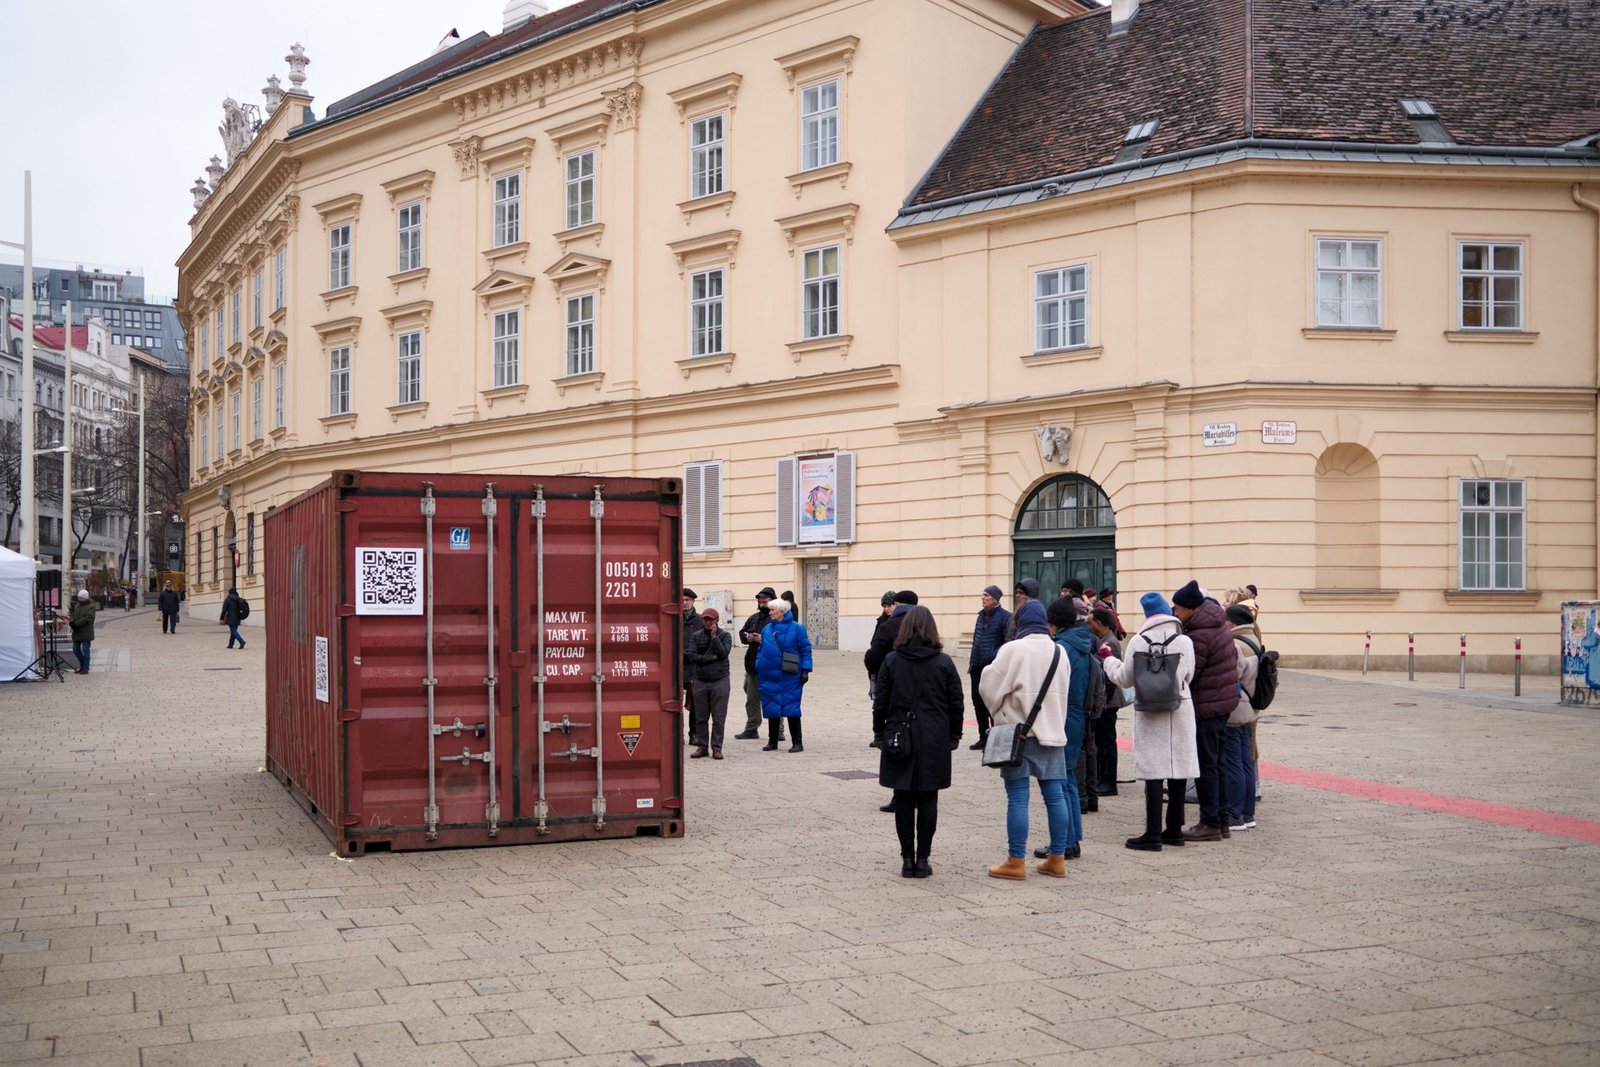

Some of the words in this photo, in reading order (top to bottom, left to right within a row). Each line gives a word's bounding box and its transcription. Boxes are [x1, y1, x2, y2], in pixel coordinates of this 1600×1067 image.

[452, 528, 469, 544] GL
[605, 562, 654, 578] 005013
[662, 562, 669, 577] 8
[605, 582, 637, 597] 22G1
[546, 629, 569, 641] TARE
[571, 629, 589, 641] WT.
[636, 634, 649, 642] LBS
[545, 647, 585, 659] PAYLOAD
[546, 664, 561, 676] CU.
[562, 664, 583, 676] CAP.
